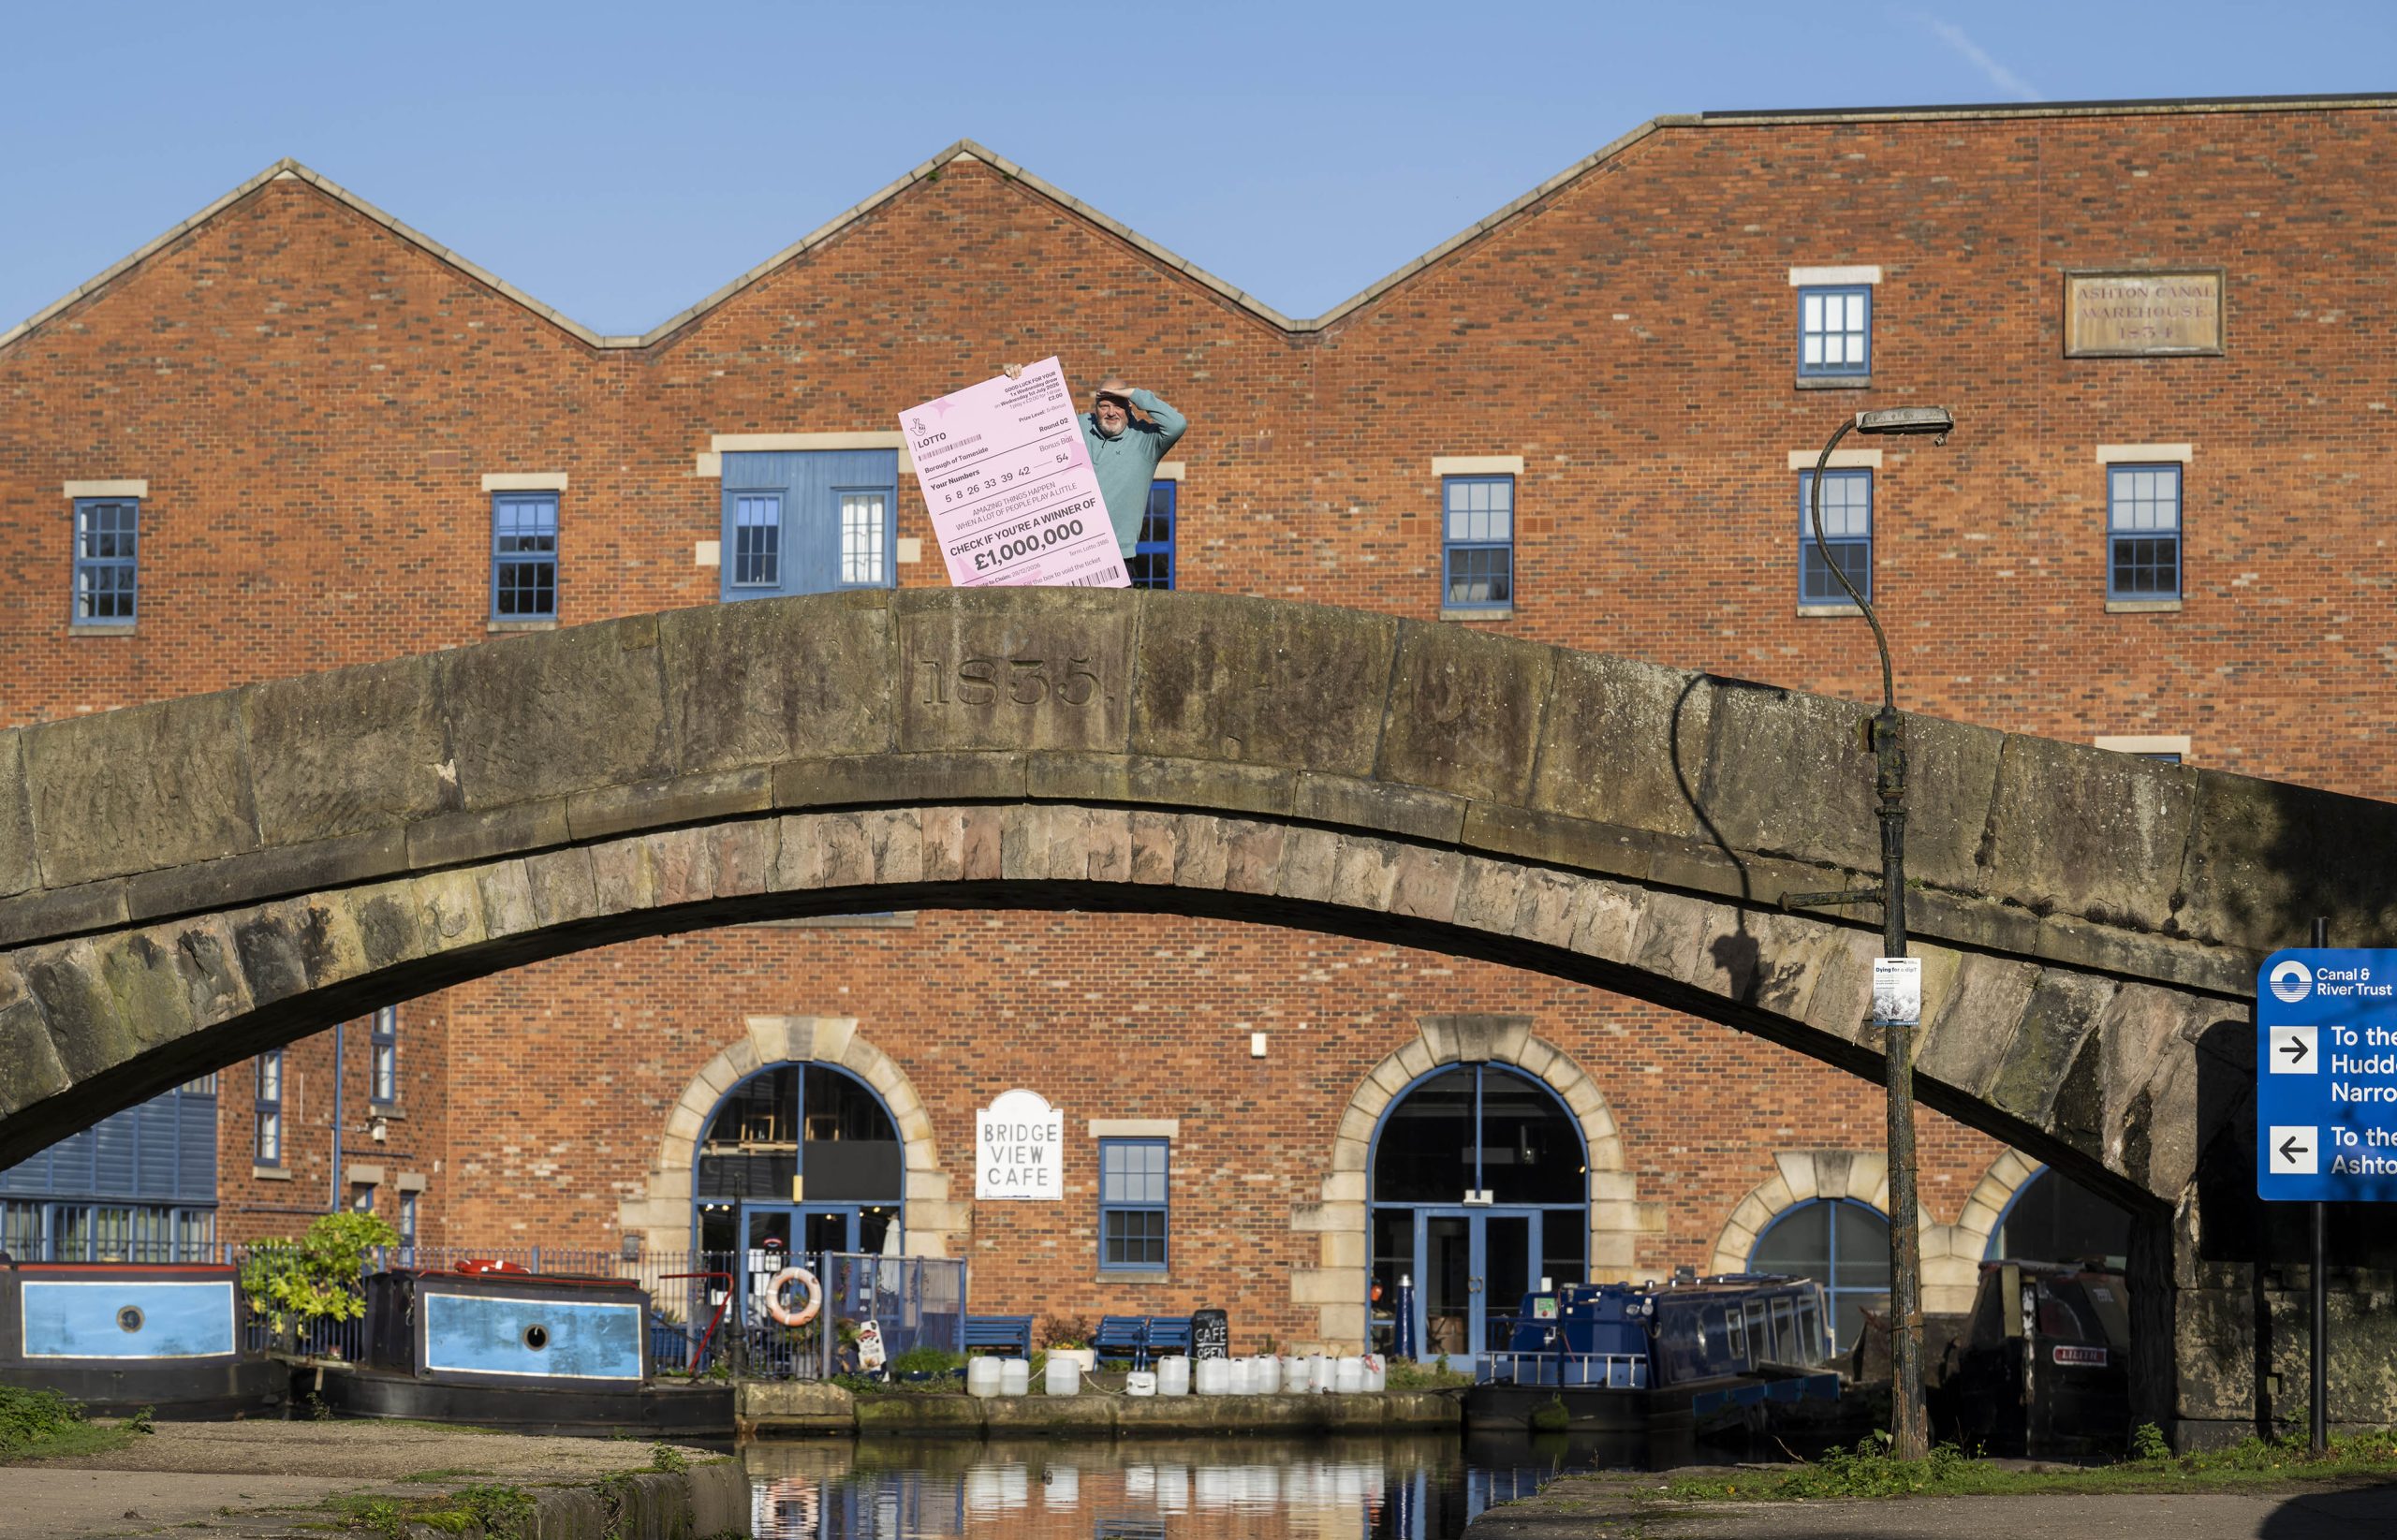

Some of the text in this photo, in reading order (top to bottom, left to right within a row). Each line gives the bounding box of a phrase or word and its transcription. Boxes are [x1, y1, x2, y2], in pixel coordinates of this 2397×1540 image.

[2079, 286, 2148, 300] ASHTON
[1017, 382, 1044, 394] Wednesday
[1000, 394, 1028, 406] Wednesday
[1039, 421, 1059, 433] Round
[918, 433, 946, 448] LOTTO
[1039, 435, 1074, 452] Bonus Ball
[924, 461, 951, 474] Borough
[958, 447, 988, 461] Tameside
[931, 470, 979, 491] Your Numbers
[946, 453, 1068, 503] 5 8 26 33 39 42 54
[956, 519, 977, 531] WHEN
[982, 511, 994, 521] LOT
[1006, 499, 1032, 513] PEOPLE
[1032, 492, 1051, 504] PLAY
[1055, 482, 1077, 495] LITTLE
[973, 481, 1055, 516] AMAZING THINGS HAPPEN
[950, 497, 1096, 556] CHECK IF YOU'RE A WINNER OF
[975, 520, 1083, 571] £1,000,000
[995, 575, 1011, 583] Claim:
[1032, 577, 1043, 585] the
[1061, 565, 1074, 575] void
[1084, 557, 1101, 566] ticket
[2316, 967, 2370, 980] Canal &
[2317, 983, 2392, 995] River Trust
[2331, 1026, 2358, 1046] To
[2331, 1054, 2397, 1074] Hudd
[984, 1123, 1057, 1142] BRIDGE
[2331, 1126, 2358, 1146] To
[992, 1145, 1043, 1164] VIEW
[2331, 1154, 2397, 1174] Ashto
[988, 1167, 1048, 1186] CAFE
[1195, 1327, 1227, 1342] CAFE
[1197, 1346, 1226, 1358] OPEN
